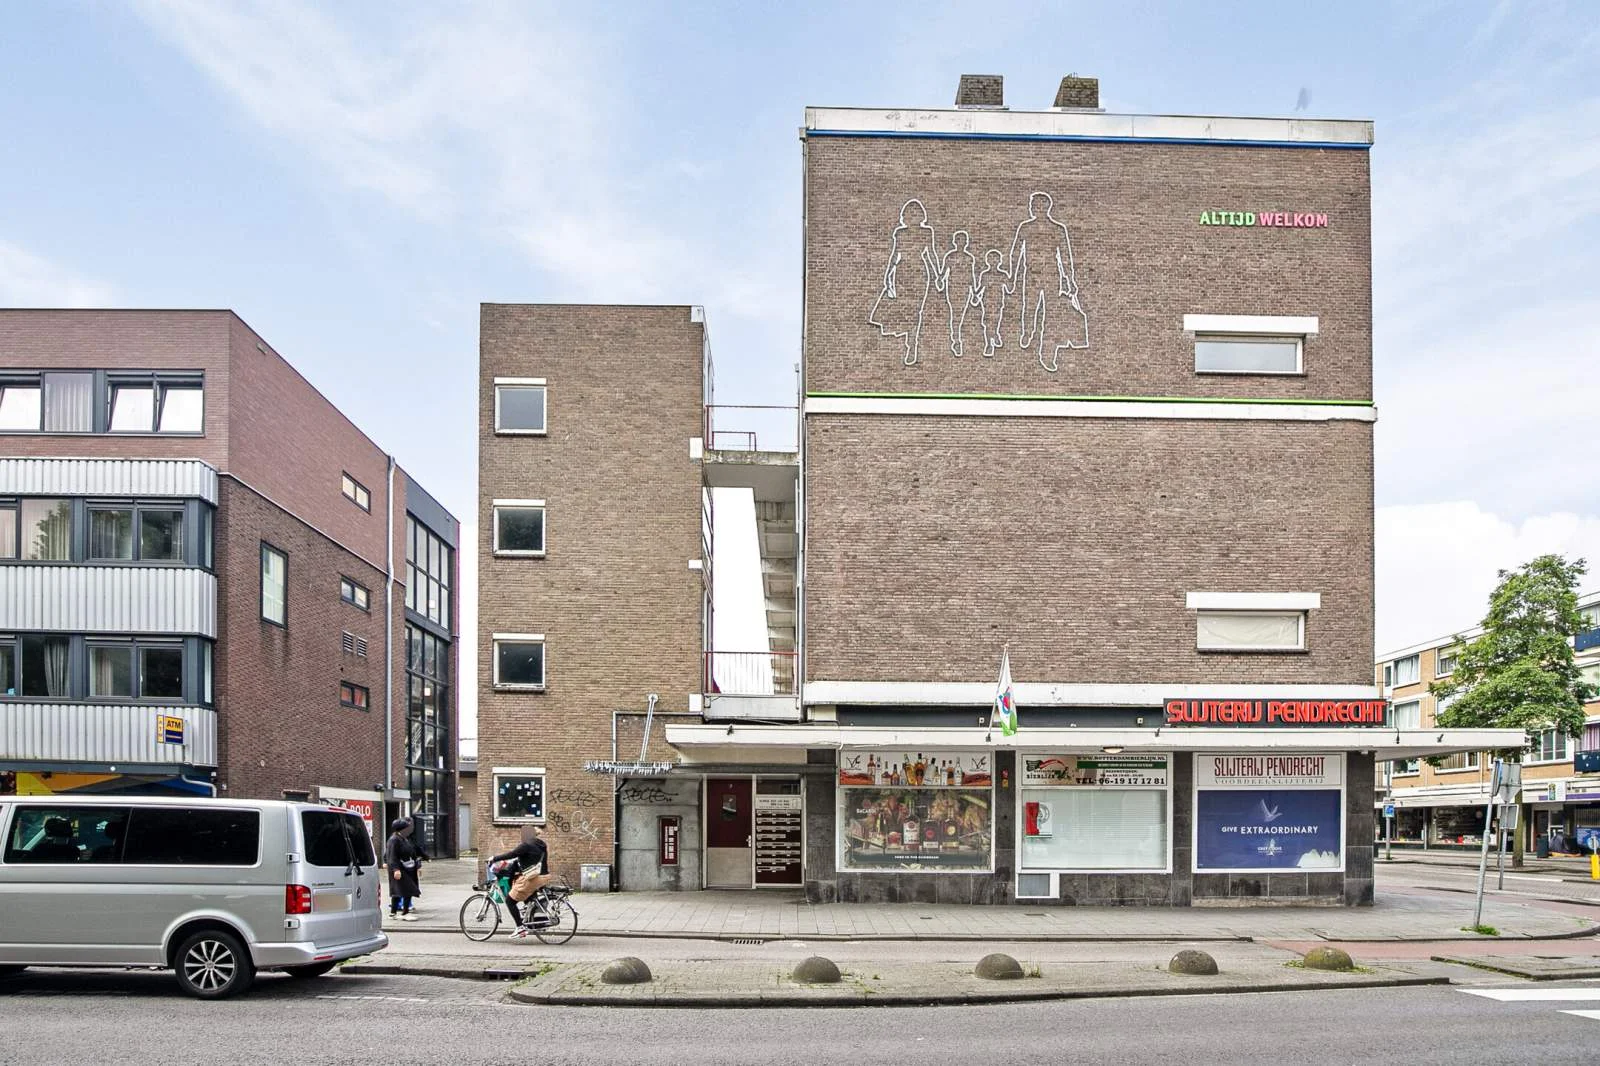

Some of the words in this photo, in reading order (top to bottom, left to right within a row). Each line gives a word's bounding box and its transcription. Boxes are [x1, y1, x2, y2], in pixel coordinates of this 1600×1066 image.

[1199, 211, 1256, 226] ALTIJD
[1259, 212, 1328, 228] WELKOM
[1166, 701, 1262, 723] SLIJTERIJ
[1267, 701, 1387, 723] PENDRECHT
[166, 720, 181, 729] ATM
[1214, 757, 1264, 776] SLIJTERIJ
[1266, 757, 1325, 776] PENDRECHT
[1099, 777, 1125, 785] 06-19
[1128, 777, 1138, 785] 17
[1141, 777, 1152, 785] 17
[1154, 777, 1165, 785] 81
[1240, 826, 1319, 834] EXTRAORDINARY
